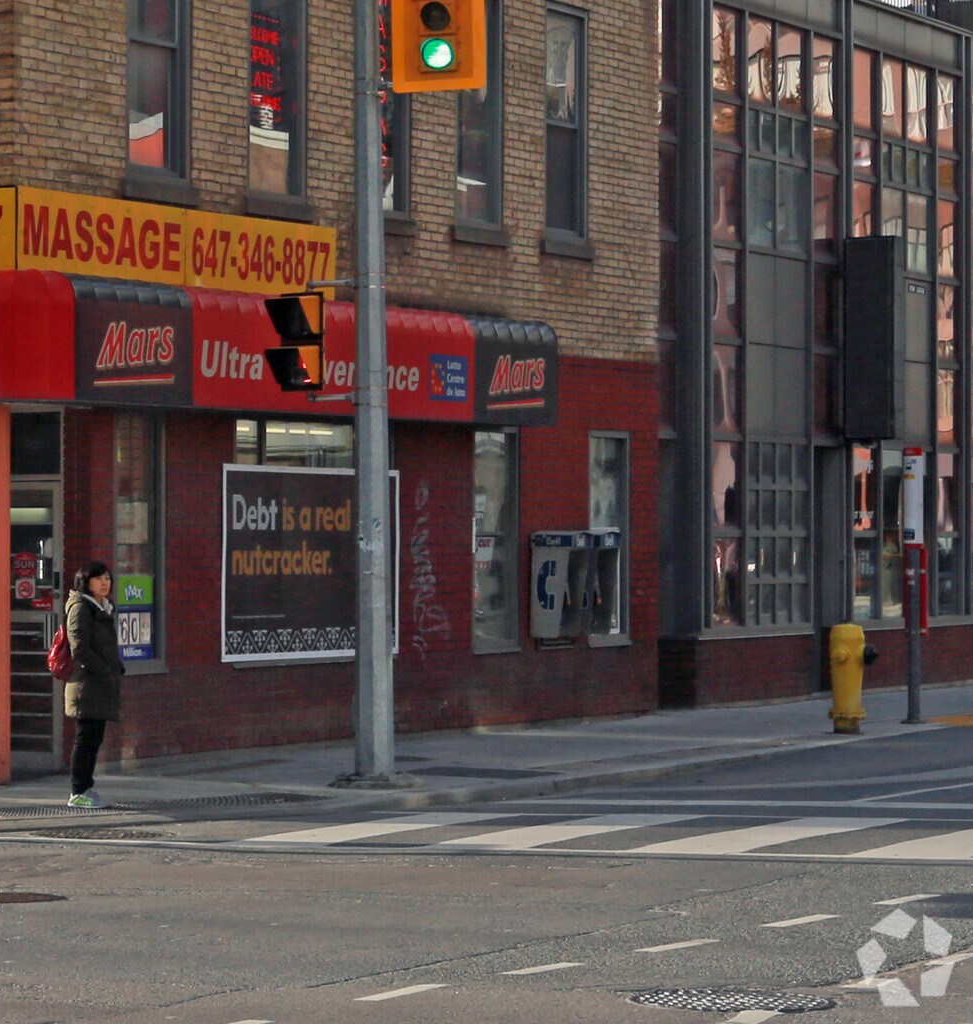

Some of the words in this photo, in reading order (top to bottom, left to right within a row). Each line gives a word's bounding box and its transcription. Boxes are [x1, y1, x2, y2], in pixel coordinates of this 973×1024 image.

[23, 204, 181, 272] MASSAGE
[192, 227, 331, 286] 647-346-8877
[96, 322, 174, 369] Mars
[201, 340, 264, 380] Ultra
[489, 357, 545, 395] Mars
[232, 494, 278, 530] Debt
[282, 498, 295, 531] is
[299, 507, 312, 531] a
[315, 499, 351, 531] real
[232, 541, 333, 575] nutcracker.
[546, 537, 561, 545] Bell
